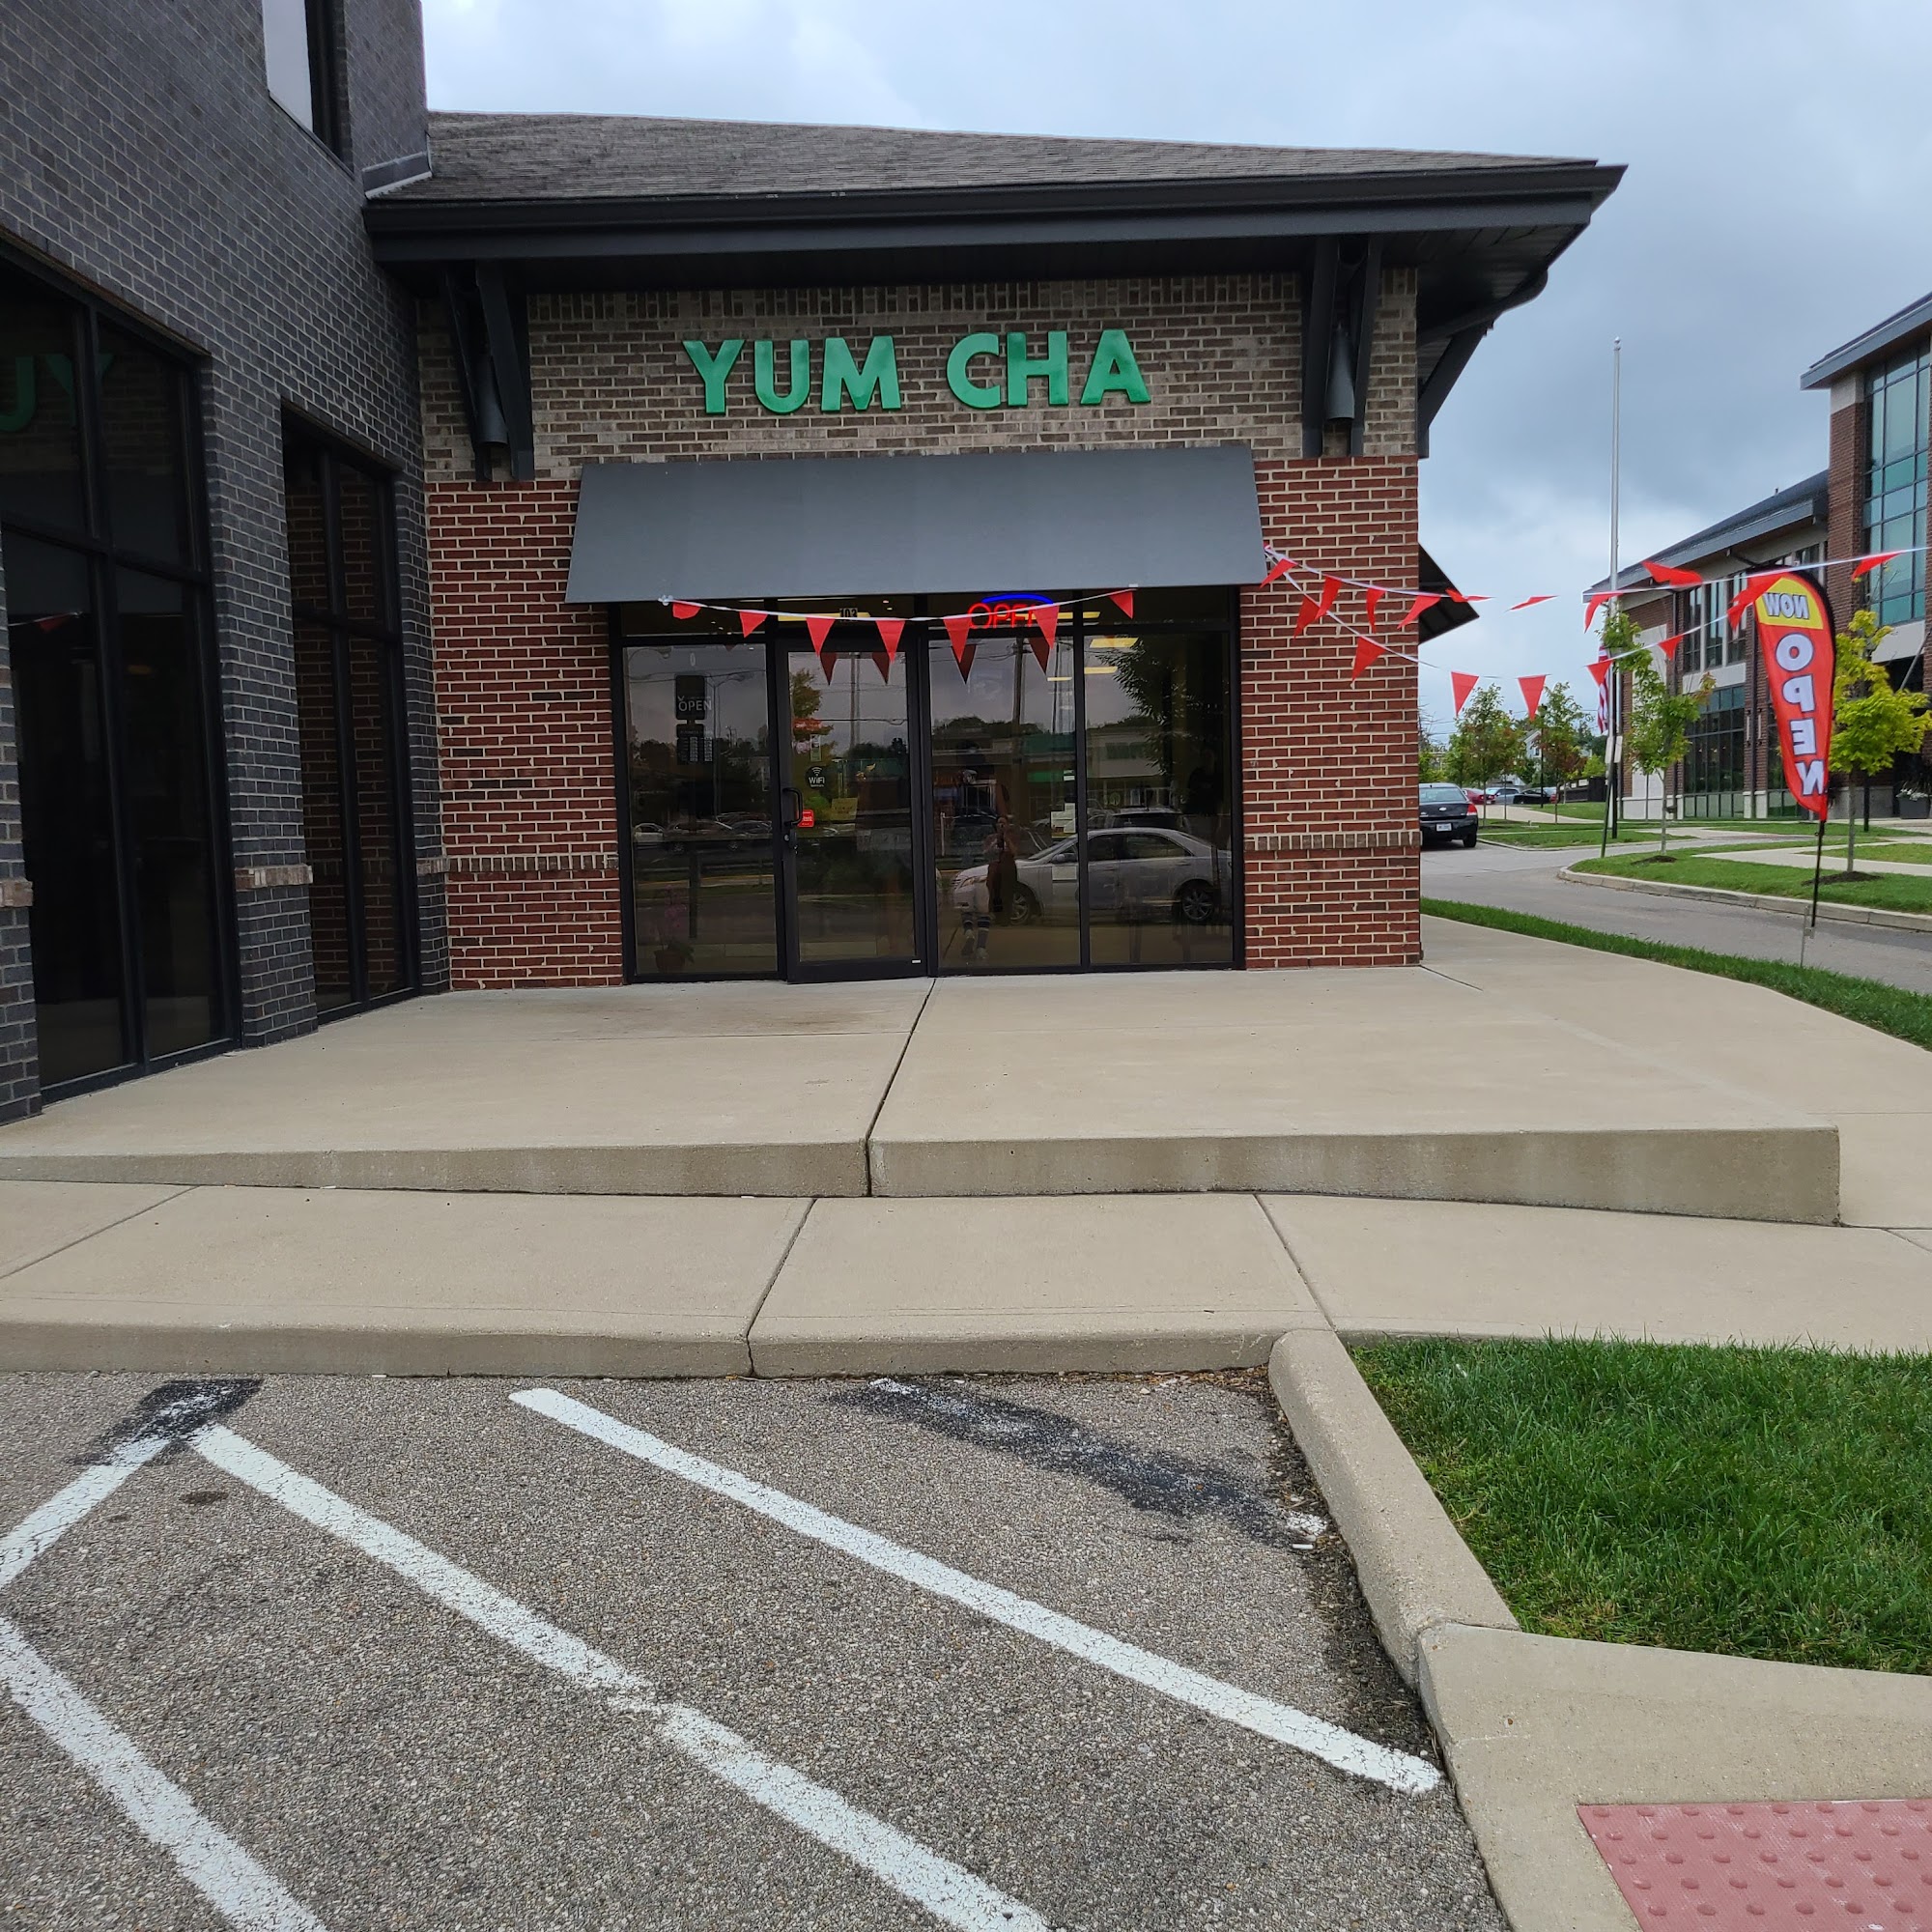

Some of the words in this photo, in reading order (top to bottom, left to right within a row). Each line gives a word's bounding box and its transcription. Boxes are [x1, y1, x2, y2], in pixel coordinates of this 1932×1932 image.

[682, 335, 902, 415] YUM
[946, 328, 1152, 411] CHA
[678, 699, 712, 712] OPEN
